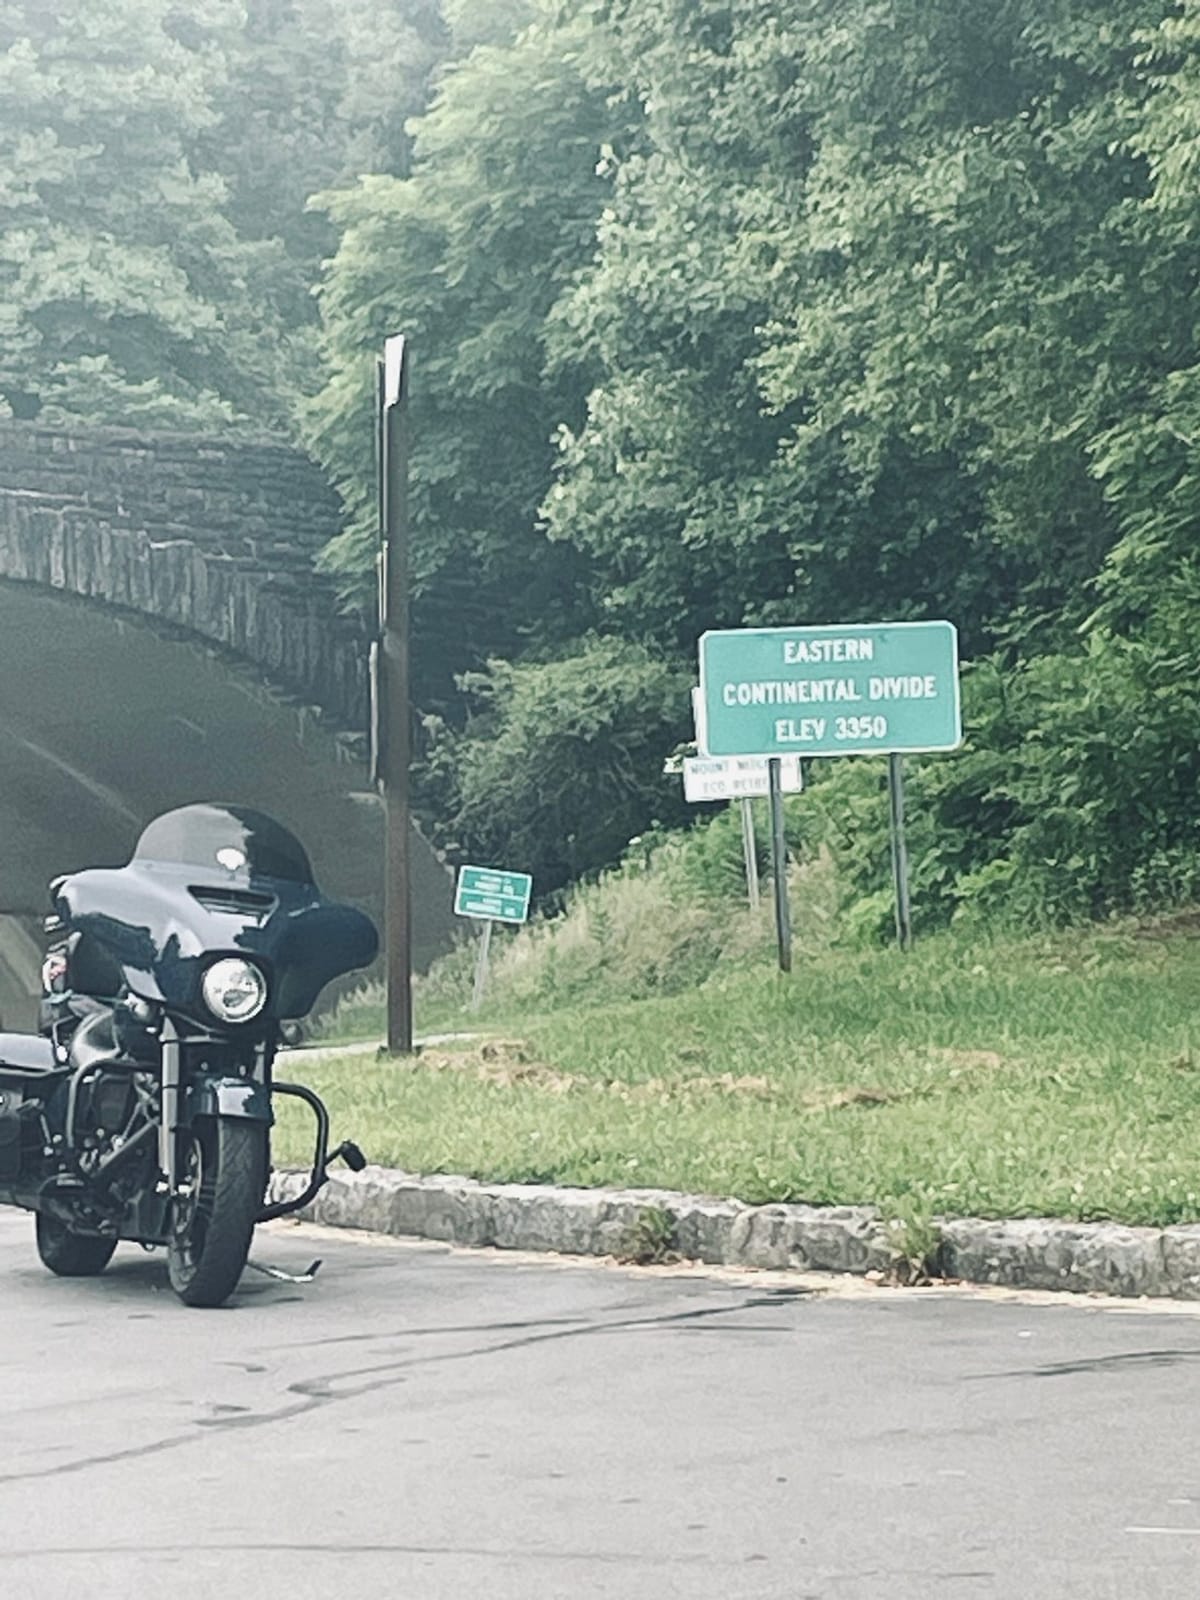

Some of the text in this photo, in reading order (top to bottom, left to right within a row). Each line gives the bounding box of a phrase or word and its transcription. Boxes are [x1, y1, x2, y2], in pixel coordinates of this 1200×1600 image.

[784, 639, 873, 664] EASTERN
[723, 676, 937, 706] CONTINENTAL DIVIDE
[775, 716, 887, 742] ELEV 3350
